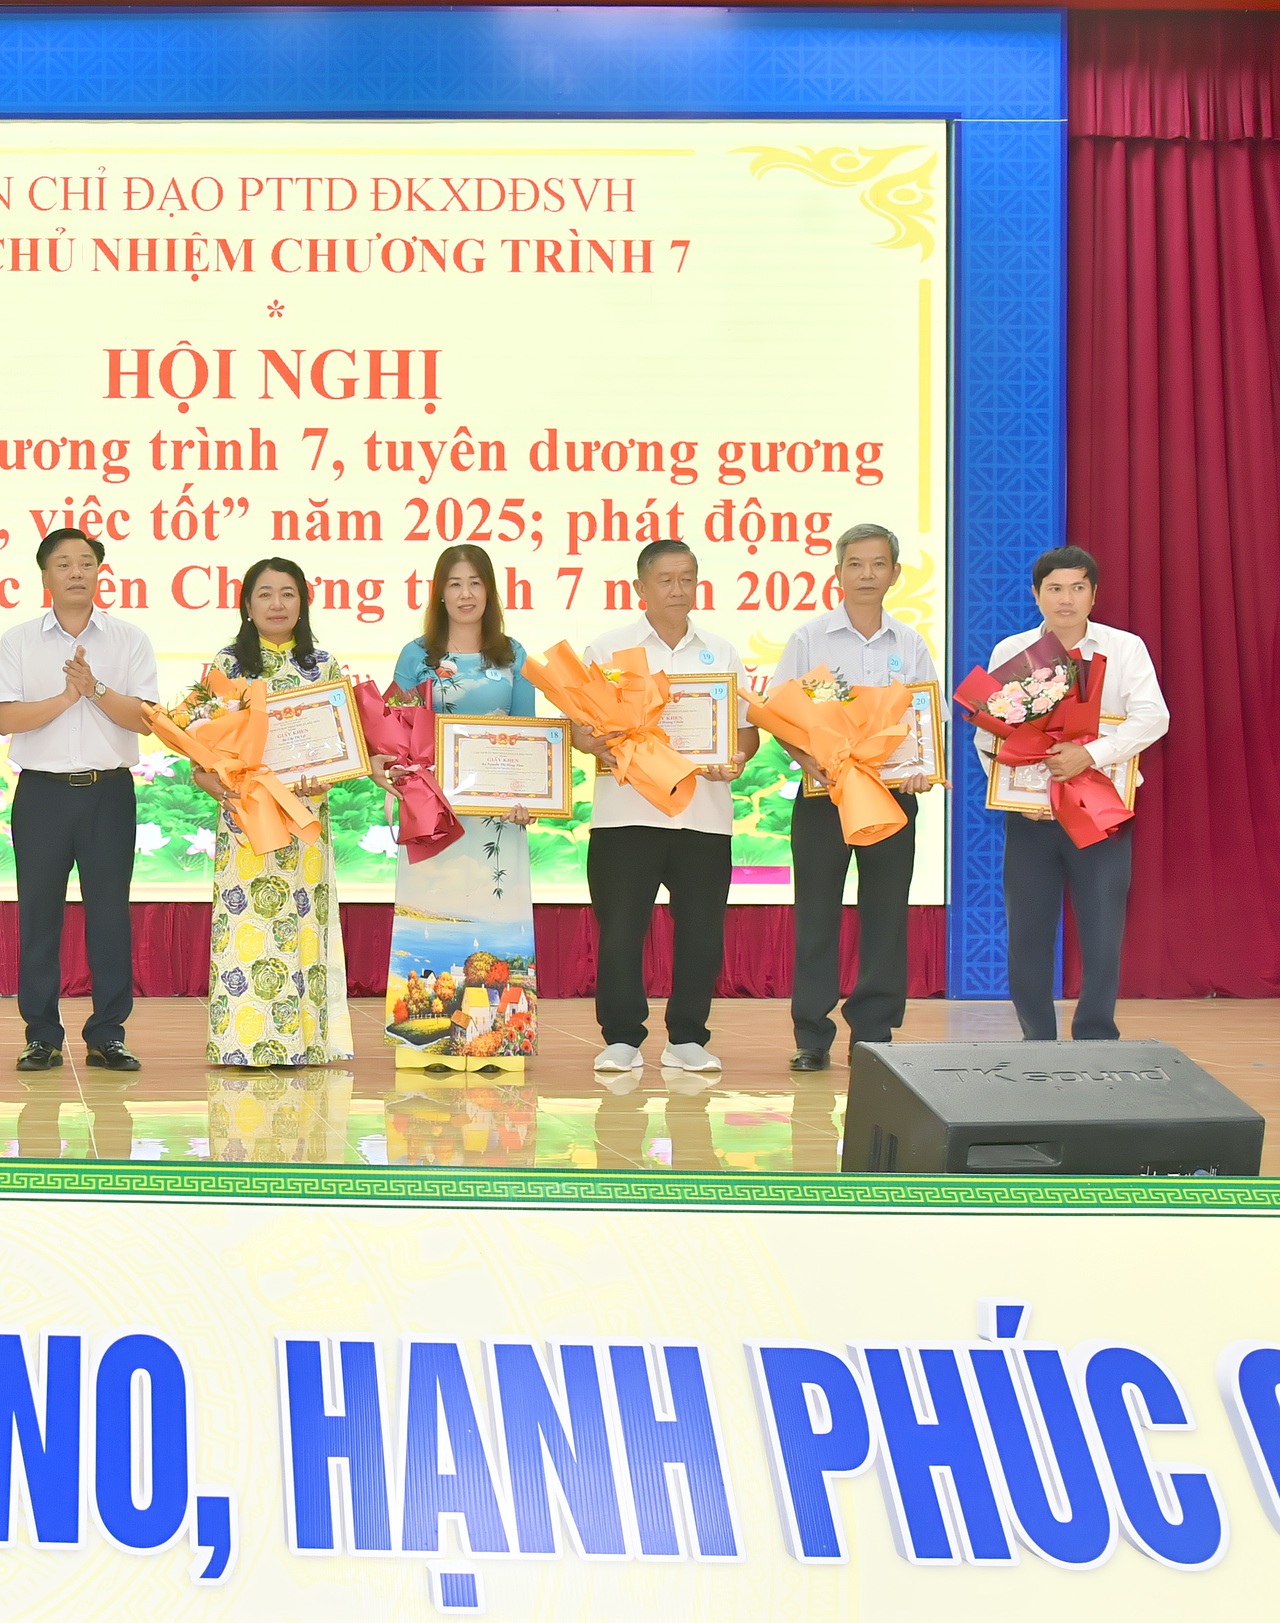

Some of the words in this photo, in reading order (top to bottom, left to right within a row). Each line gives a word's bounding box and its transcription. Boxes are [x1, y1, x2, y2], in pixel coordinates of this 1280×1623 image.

[28, 165, 108, 212] CHỈ
[122, 176, 224, 218] ĐẠO
[238, 177, 358, 212] PTTD
[370, 176, 635, 213] ĐKXDĐSVH
[90, 231, 256, 283] NHIỆM
[270, 231, 487, 274] CHƯƠNG
[500, 228, 655, 274] TRÌNH
[669, 239, 692, 273] 7
[102, 340, 237, 414] HỘI
[259, 348, 443, 415] NGHỊ
[149, 422, 278, 472] trình
[300, 427, 346, 480] 7,
[364, 426, 508, 485] tuyên
[528, 428, 699, 486] dương
[717, 438, 885, 486] gương
[150, 482, 250, 541] tốt”
[271, 497, 384, 542] năm
[404, 497, 544, 552] 2025;
[566, 497, 686, 557] phát
[704, 497, 834, 556] động
[556, 567, 584, 610] 7
[702, 653, 711, 661] 19
[890, 659, 899, 667] 20
[332, 693, 342, 702] 17
[916, 698, 926, 706] 20
[550, 731, 559, 739] 18
[1022, 1065, 1172, 1083] sound
[284, 1340, 739, 1608] HẠNH
[760, 1305, 1222, 1565] PHÚC
